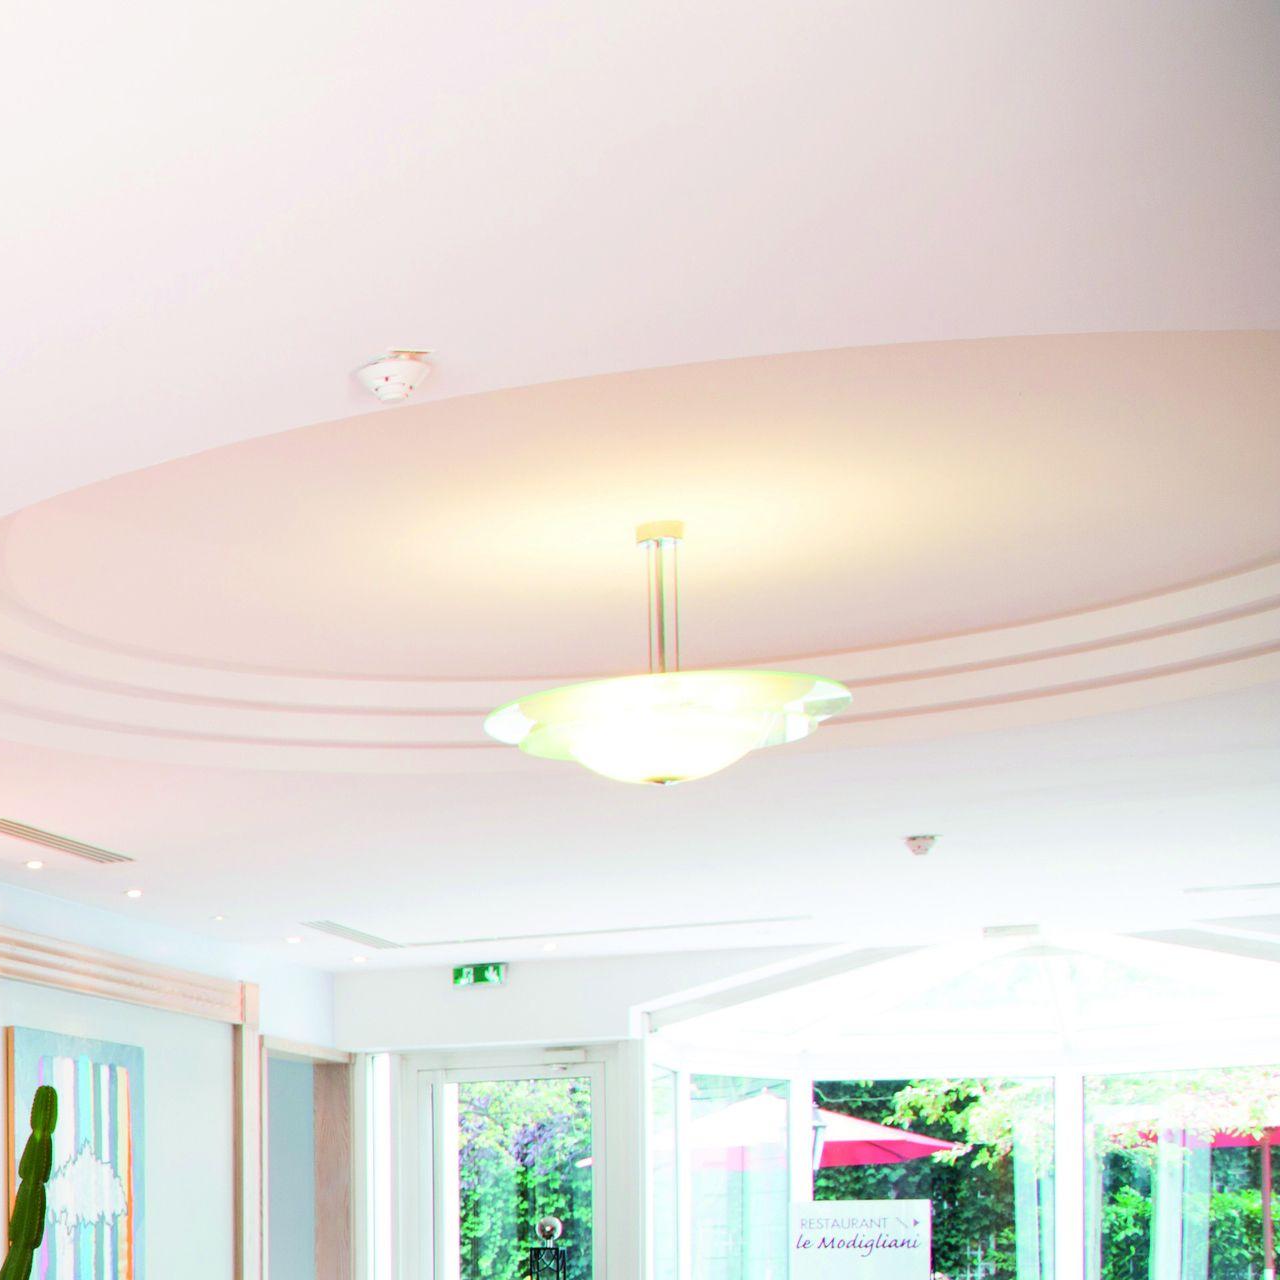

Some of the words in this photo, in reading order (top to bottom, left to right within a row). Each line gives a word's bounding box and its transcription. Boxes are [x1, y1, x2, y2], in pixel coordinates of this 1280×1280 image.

[800, 1217, 888, 1230] RESTAURANT
[796, 1233, 812, 1249] le
[817, 1232, 921, 1258] Modigliani
